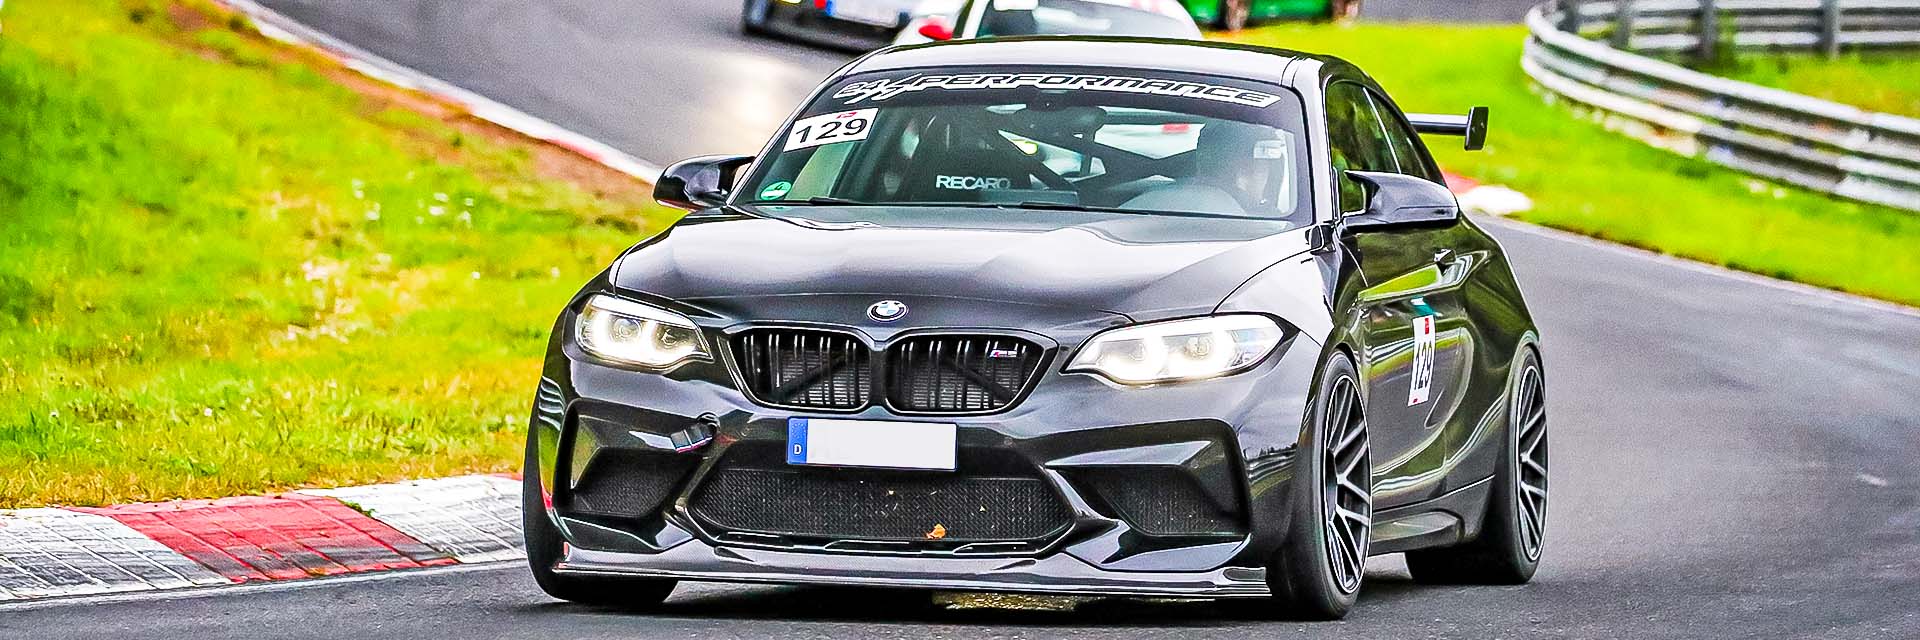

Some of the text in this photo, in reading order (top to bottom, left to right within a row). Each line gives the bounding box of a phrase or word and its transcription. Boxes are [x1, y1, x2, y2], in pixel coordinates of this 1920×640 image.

[908, 73, 1281, 108] PERFORMANCE
[796, 119, 867, 143] 129
[935, 175, 1010, 189] RECARO
[1414, 341, 1433, 390] 129
[794, 444, 802, 455] D
